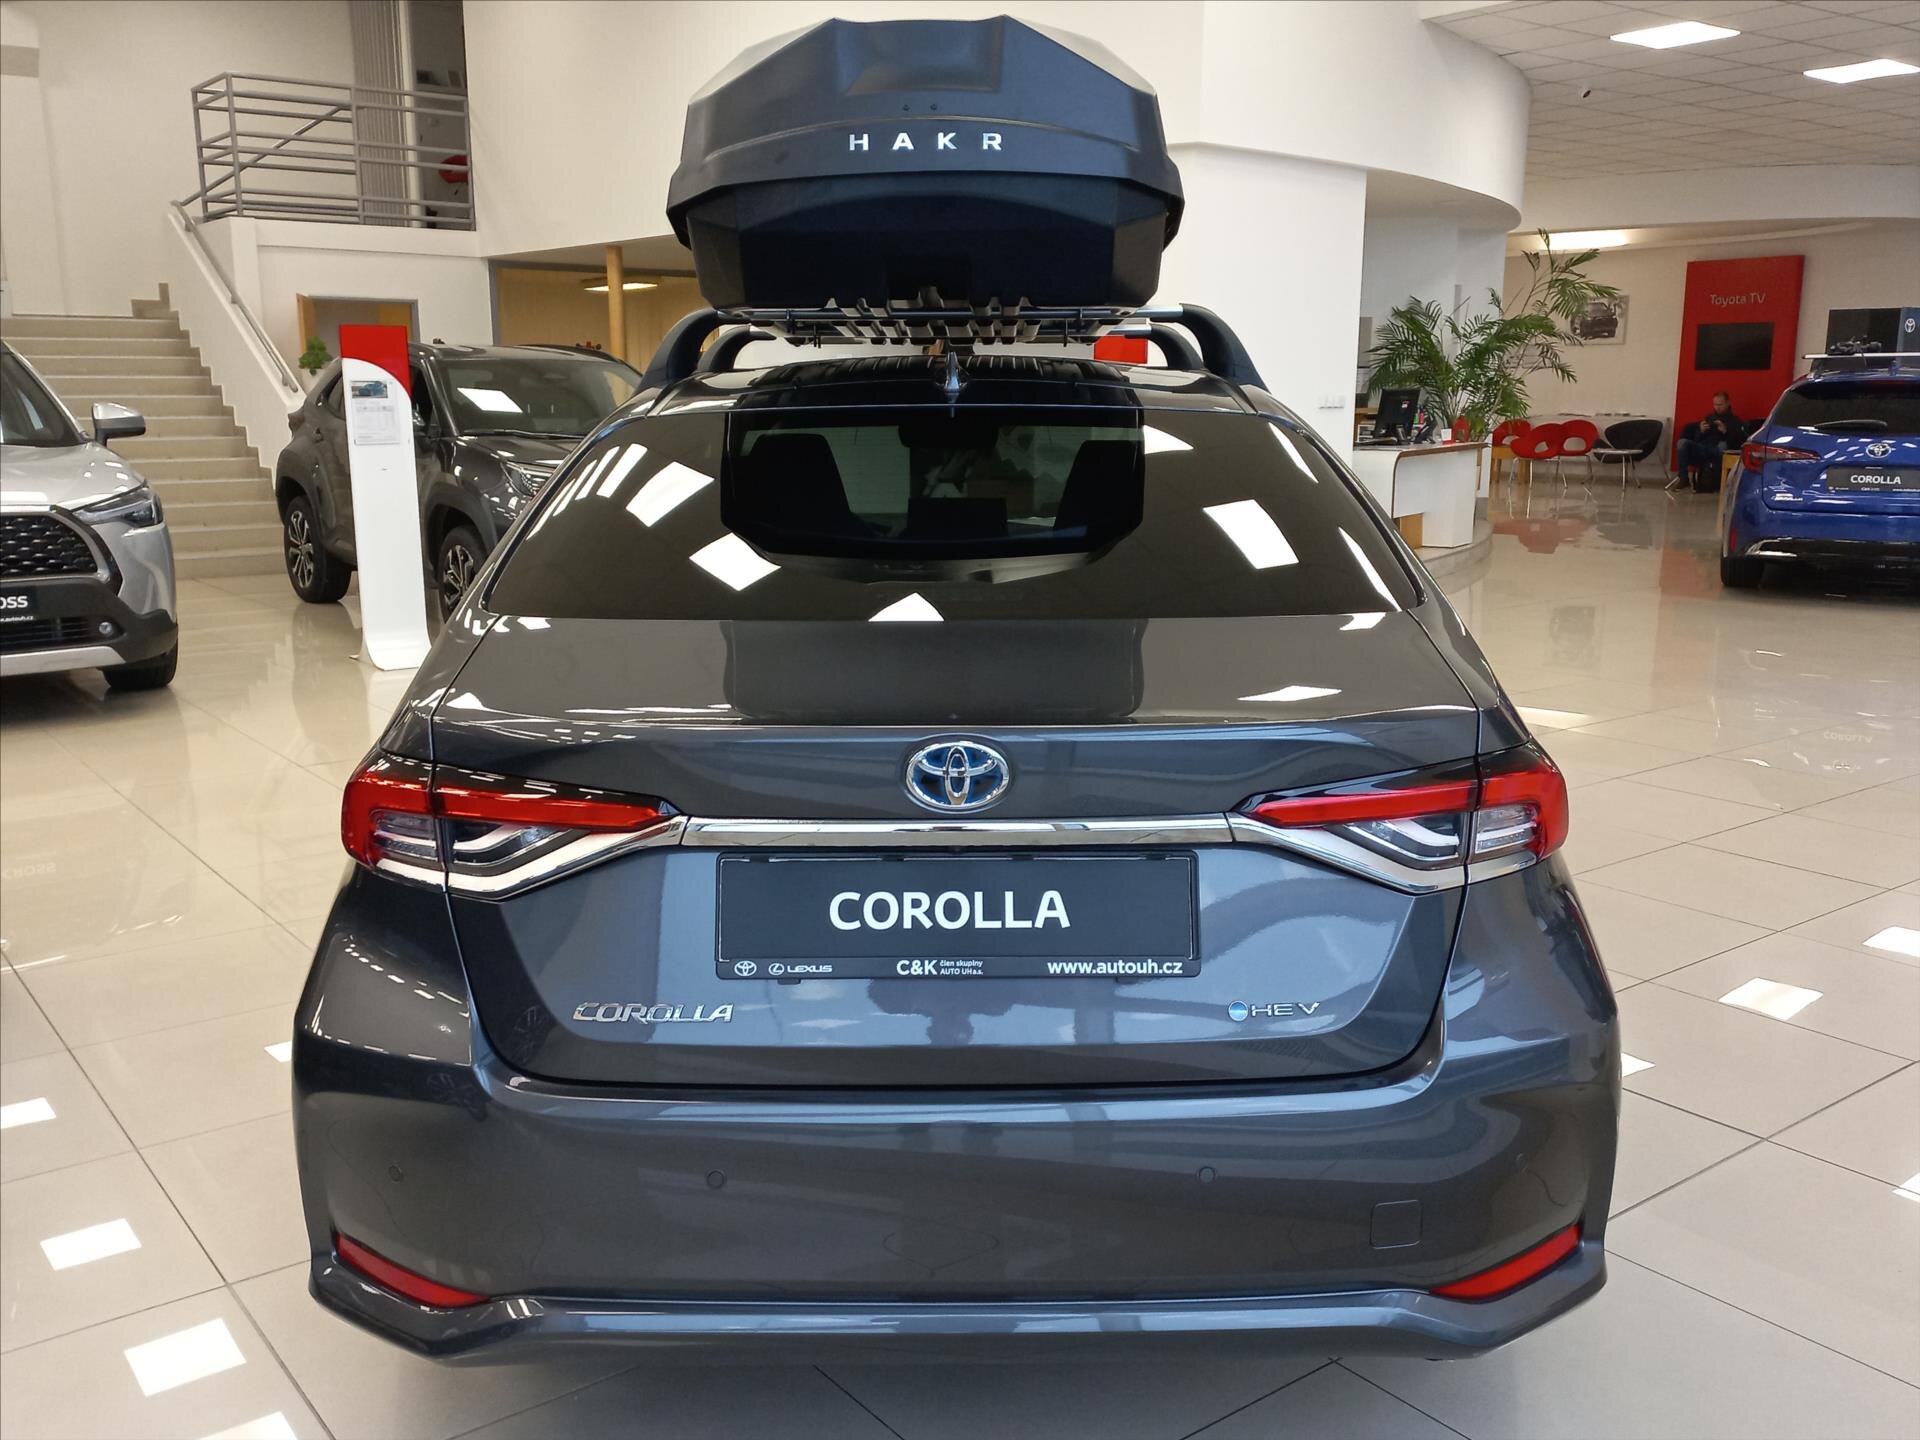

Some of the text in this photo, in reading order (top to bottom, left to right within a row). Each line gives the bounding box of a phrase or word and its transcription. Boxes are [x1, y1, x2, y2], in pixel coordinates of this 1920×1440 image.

[849, 132, 1003, 151] HAKR
[1710, 292, 1766, 308] Toyota TV
[1850, 475, 1901, 485] COROLLA
[829, 890, 1071, 931] COROLLA
[787, 964, 833, 974] LEXUS
[896, 959, 938, 976] C&K
[940, 968, 960, 976] AUTO
[1047, 959, 1183, 975] www.autouh.cz
[572, 1002, 734, 1025] COROLLA
[1251, 1001, 1320, 1017] HEV
